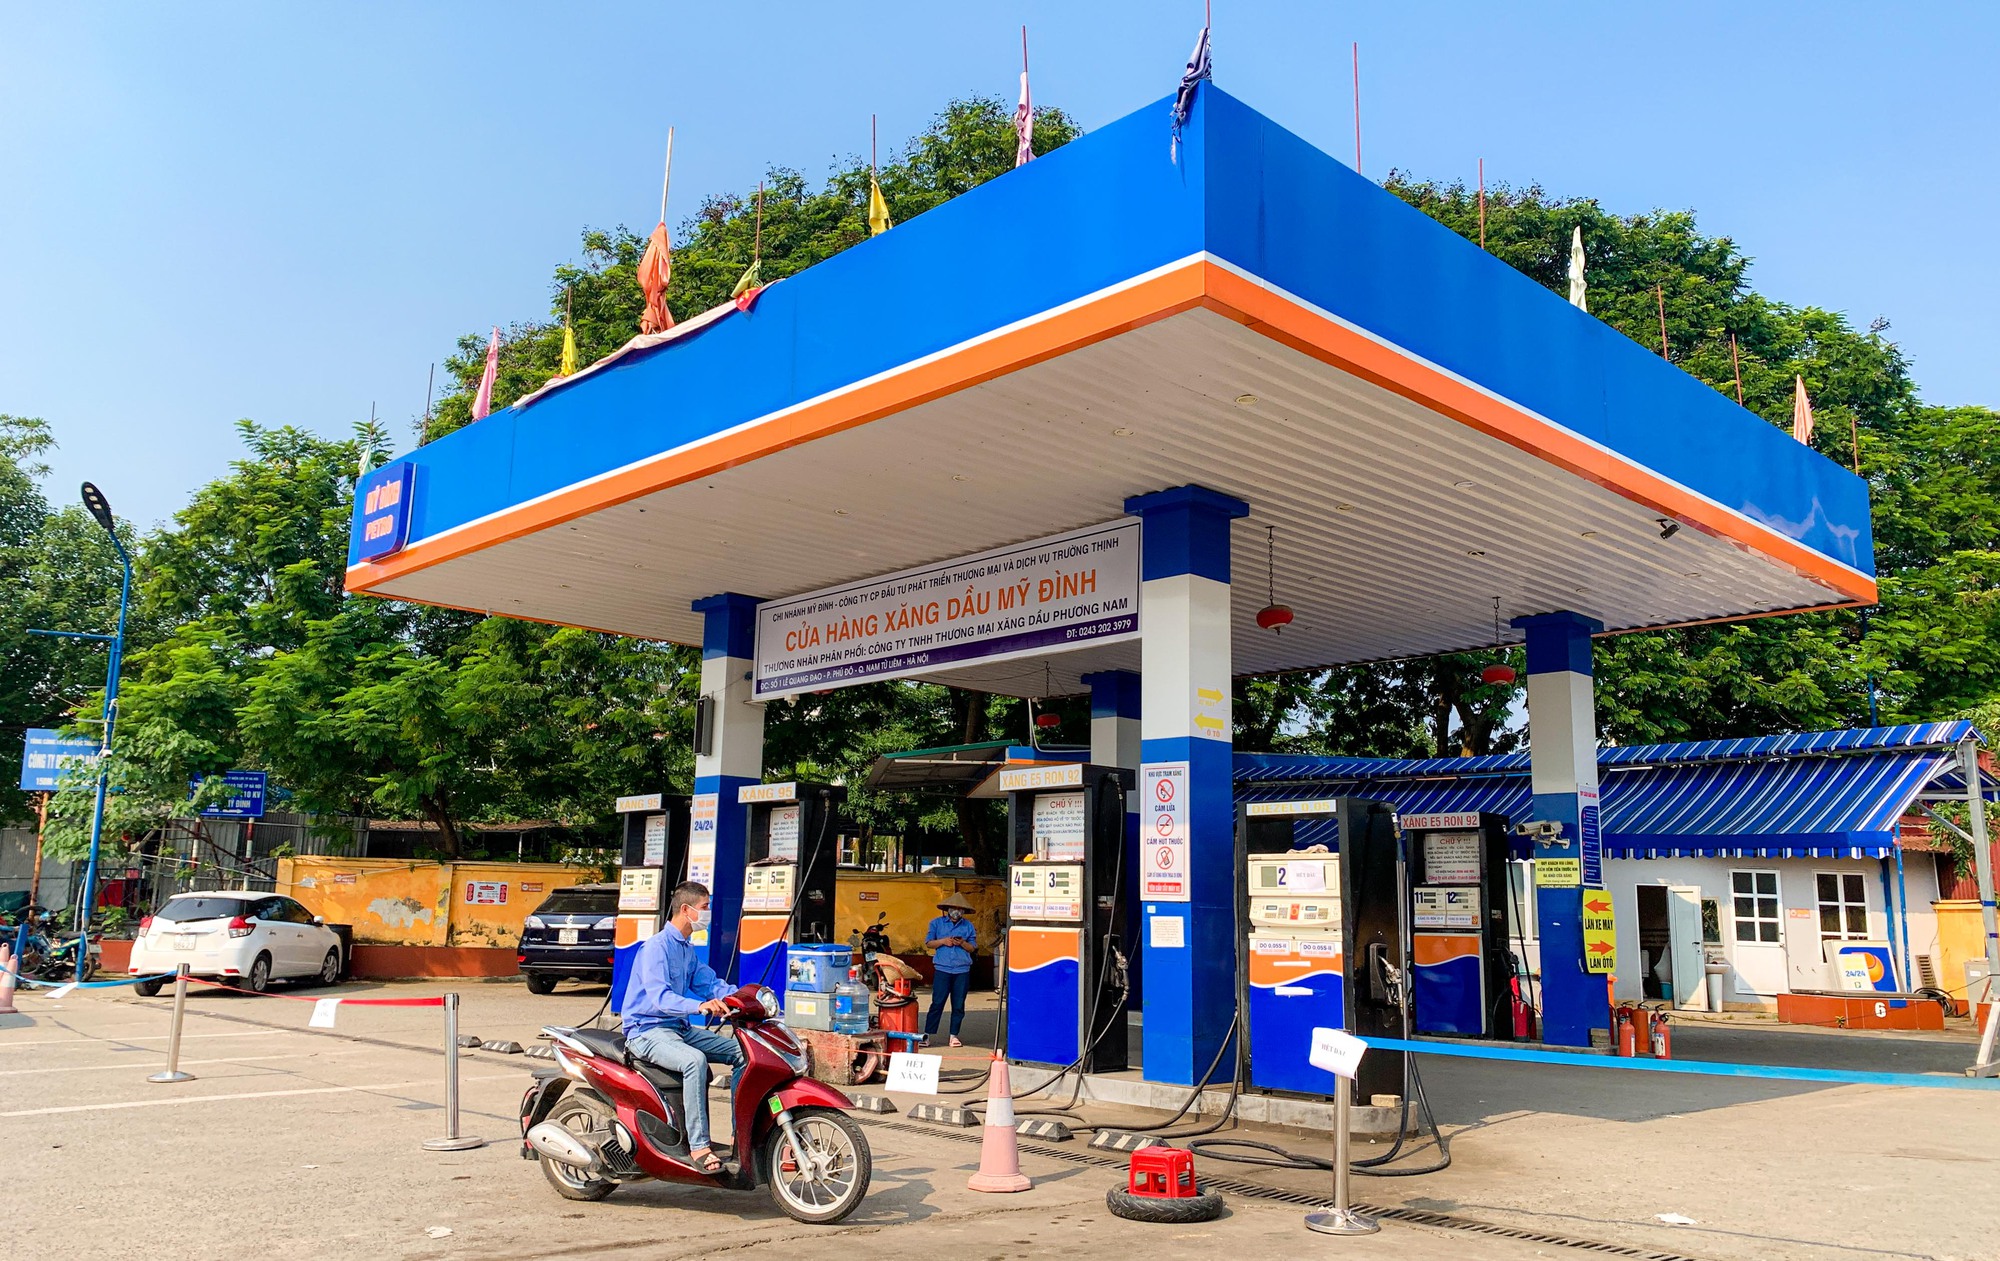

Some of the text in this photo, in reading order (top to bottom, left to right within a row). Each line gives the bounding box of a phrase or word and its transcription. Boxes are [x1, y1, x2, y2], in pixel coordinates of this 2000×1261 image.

[365, 514, 394, 541] PETRO
[773, 613, 783, 622] CHI
[784, 607, 806, 620] NHÁNH
[807, 605, 816, 614] MỸ
[818, 601, 833, 612] ĐÌNH
[839, 596, 858, 608] CÔNG
[860, 593, 868, 603] TY
[870, 591, 880, 601] CP
[881, 585, 895, 598] ĐẦU
[897, 584, 907, 595] TƯ
[908, 579, 927, 593] PHÁT
[929, 571, 951, 588] TRIỂN
[953, 567, 985, 583] THƯƠNG
[987, 564, 1001, 576] MẠI
[1003, 559, 1014, 572] VÀ
[1016, 555, 1036, 570] DỊCH
[1039, 553, 1050, 565] VỤ
[1053, 544, 1089, 561] TRƯỜNG
[1092, 537, 1119, 552] THỊNH
[786, 569, 1096, 652] CỬA HÀNG XĂNG DẦU MỸ ĐÌNH
[1066, 619, 1131, 638] ĐT: 0243 202 3979
[764, 598, 1128, 674] THƯƠNG NHÂN PHÂN PHỐI: CÔNG TY TNHH THƯƠNG MẠI XĂNG DẦU PHƯƠNG NAM
[866, 663, 880, 673] NAM
[907, 655, 916, 665] HÀ
[917, 653, 928, 664] NỘI
[1002, 769, 1080, 788] XĂNG E5 RON 92
[741, 786, 793, 801] XĂNG 95
[618, 797, 658, 811] XĂNG 95
[1050, 798, 1066, 809] CHÚ
[1067, 798, 1073, 808] Ý
[1252, 803, 1296, 814] DIEZEL
[694, 820, 713, 831] 24/24
[1403, 815, 1477, 828] XĂNG E5 RON 92
[623, 874, 627, 885] 8
[641, 874, 645, 886] 7
[747, 872, 752, 885] 6
[770, 871, 776, 884] 5
[1014, 871, 1021, 886] 4
[1048, 872, 1056, 888] 3
[1278, 867, 1286, 885] 2
[1414, 892, 1423, 904] 11
[1446, 891, 1456, 904] 12
[1584, 916, 1614, 930] LÀN XE MÁY
[1874, 1001, 1886, 1018] 6
